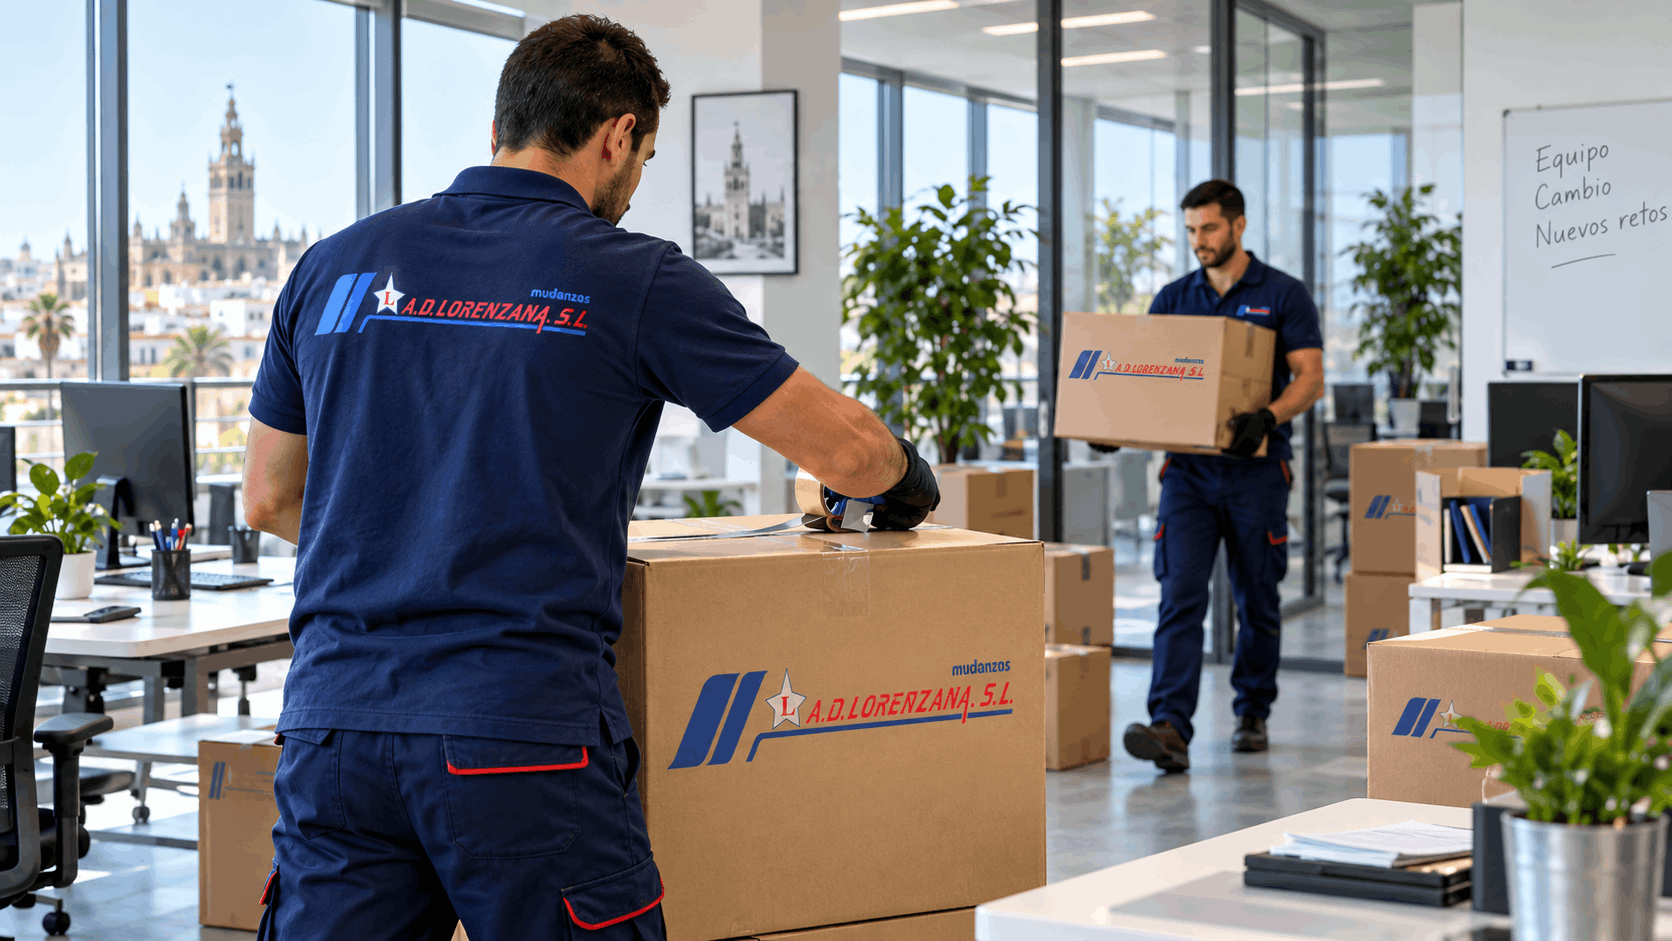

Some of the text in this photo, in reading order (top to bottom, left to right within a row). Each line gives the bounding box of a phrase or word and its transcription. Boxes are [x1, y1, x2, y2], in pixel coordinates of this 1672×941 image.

[1536, 143, 1609, 179] Equipo
[1535, 176, 1611, 210] Cambio
[1536, 201, 1668, 248] Nuevos retos
[781, 696, 796, 717] L
